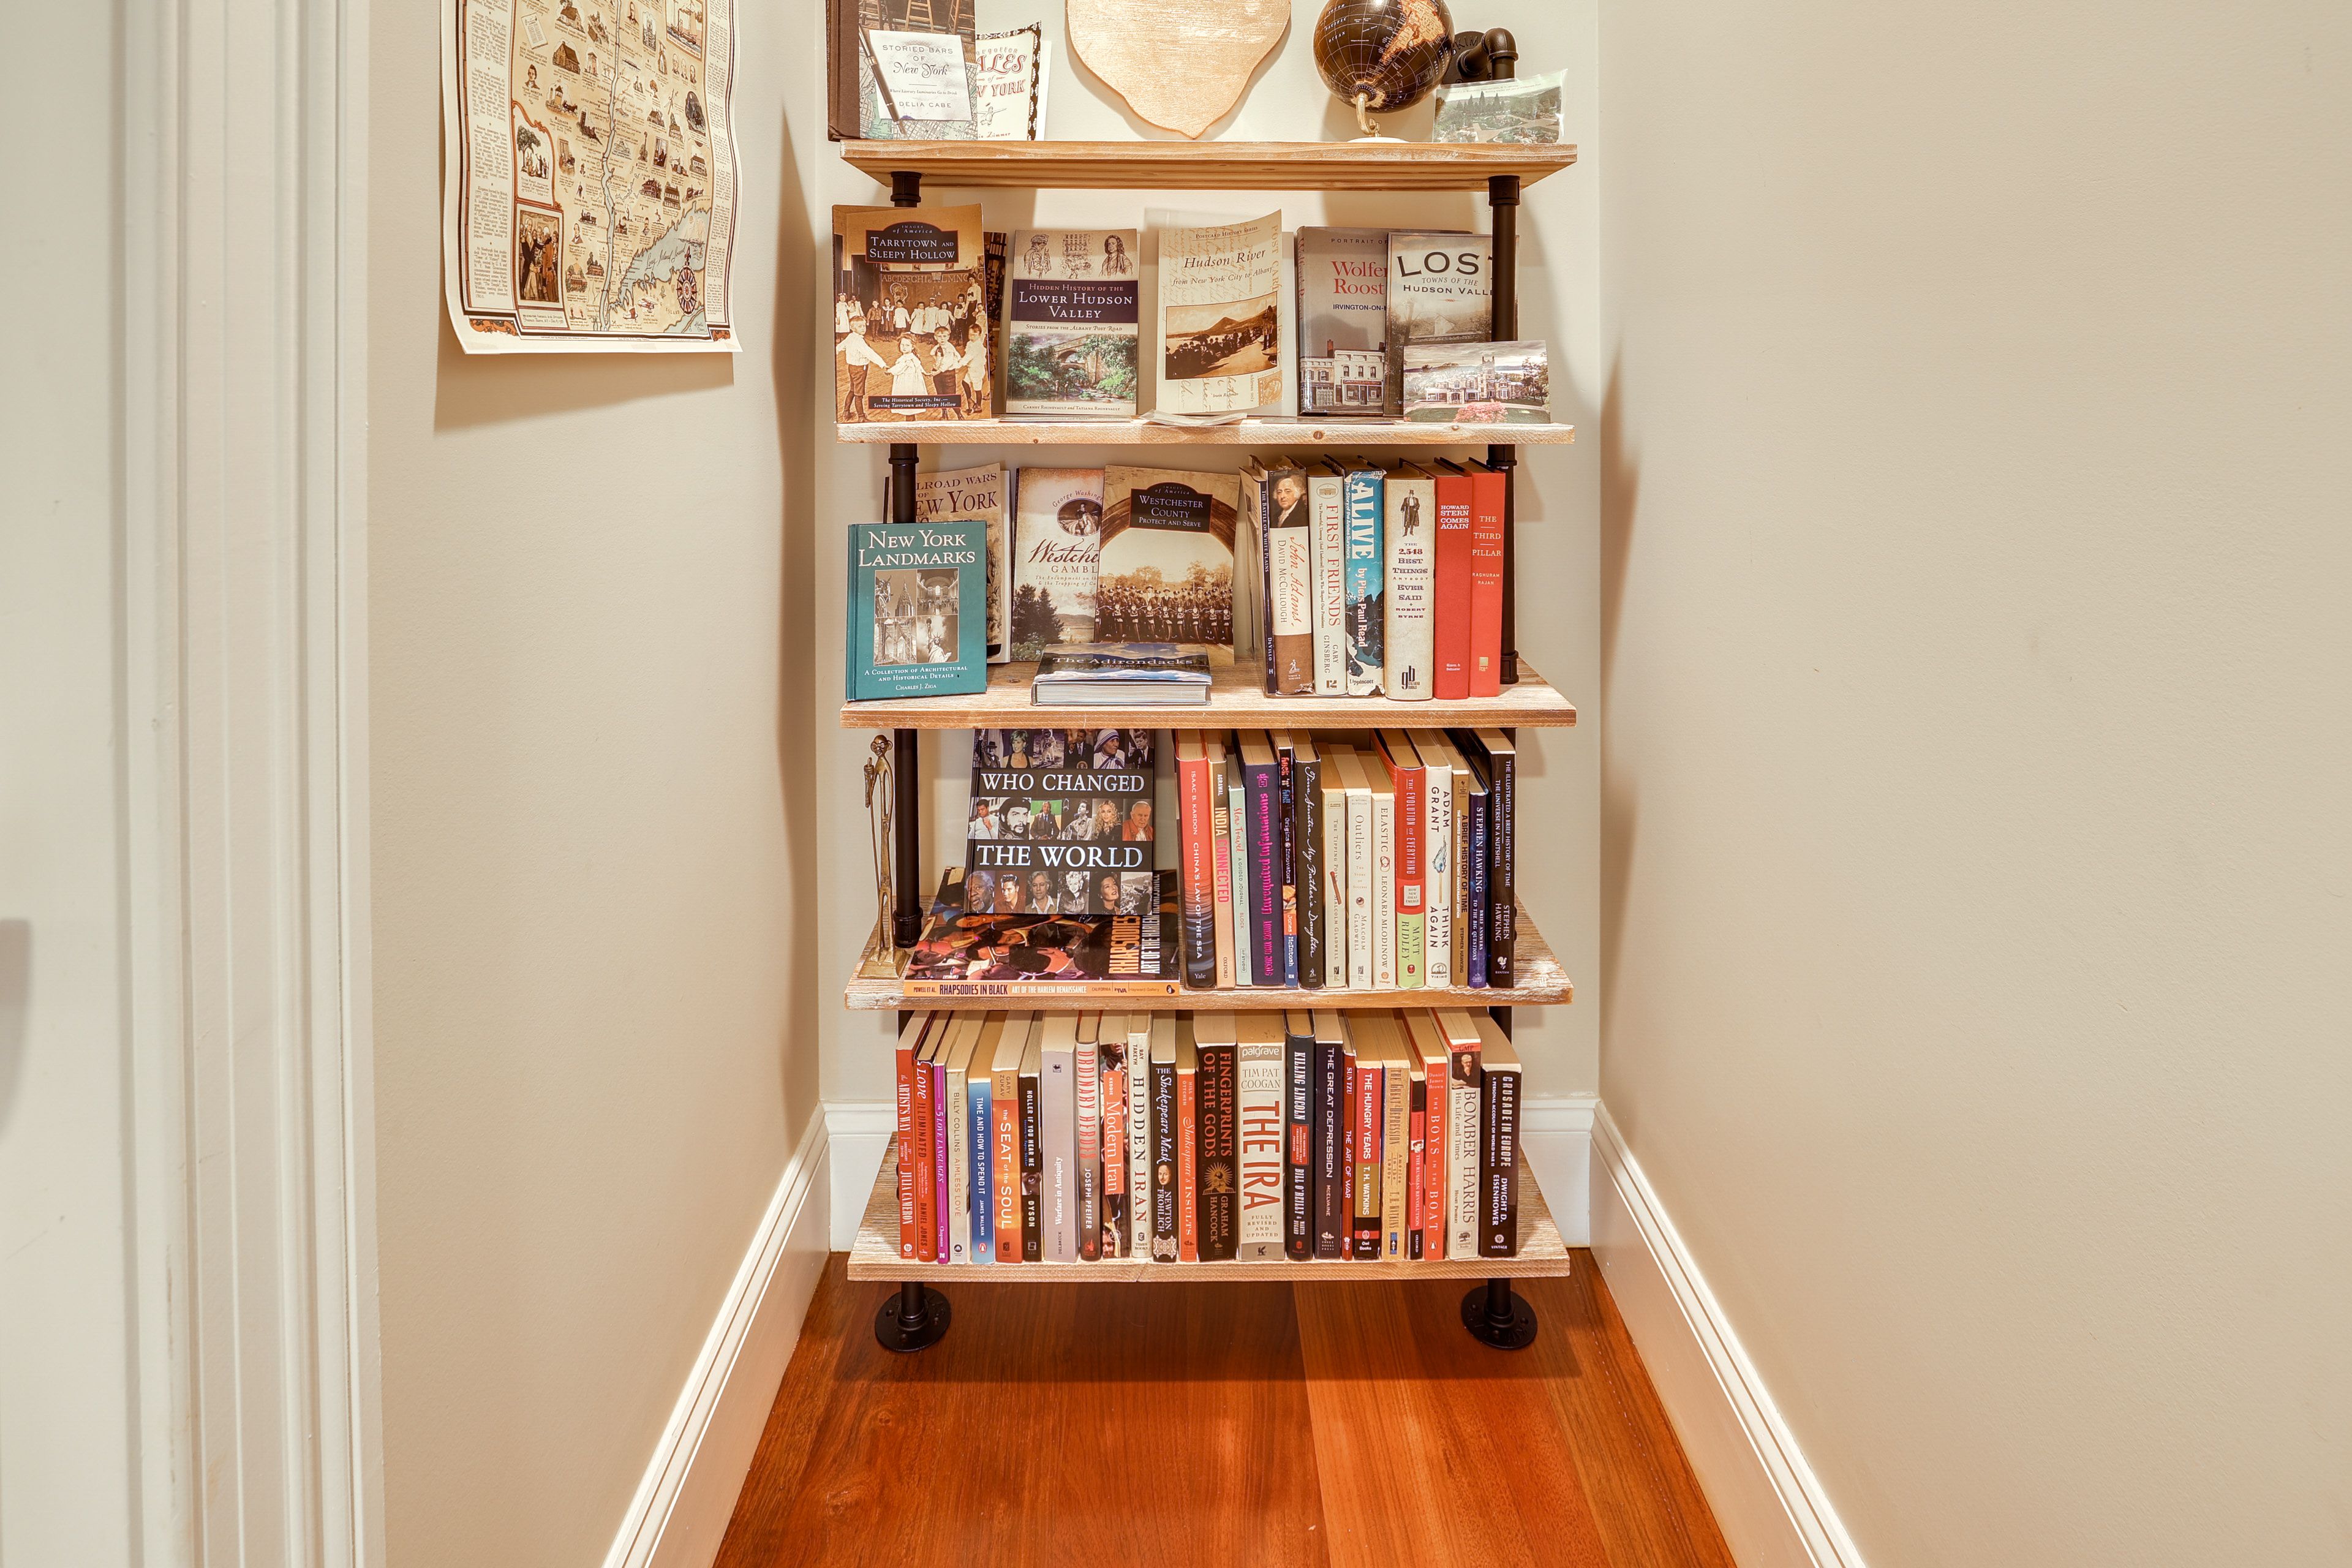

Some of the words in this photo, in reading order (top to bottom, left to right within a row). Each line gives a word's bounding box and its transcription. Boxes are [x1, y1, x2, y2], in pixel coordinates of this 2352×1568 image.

[893, 62, 918, 74] New
[921, 63, 949, 78] York
[991, 80, 1026, 97] YORK
[870, 237, 937, 247] TARRYTOWN
[870, 249, 905, 259] SLEEPY
[911, 250, 955, 259] HOLLOW
[1184, 254, 1230, 268] Hudson
[1237, 249, 1265, 263] River
[1253, 266, 1273, 276] Albany
[1333, 278, 1385, 295] Roost
[1403, 285, 1452, 293] HUDSON
[1019, 292, 1068, 303] LOWER
[1073, 293, 1133, 304] HUDSON
[1049, 306, 1101, 318] VALLEY
[1139, 496, 1203, 508] WESTCHESTER
[1152, 507, 1189, 518] COUNTY
[1327, 505, 1339, 552] FIRST
[1351, 482, 1374, 559] ALIVE
[868, 531, 914, 549] NEW
[918, 529, 967, 547] YORK
[858, 550, 975, 567] LANDMARKS
[1278, 540, 1286, 564] DAVID
[1355, 568, 1368, 579] by
[1327, 559, 1341, 626] FRIENDS
[1357, 580, 1367, 601] Piers
[1357, 603, 1367, 625] Paul
[1358, 625, 1368, 647] Read
[982, 774, 1034, 790] WHO
[1042, 775, 1144, 791] CHANGED
[1355, 815, 1364, 860] Outliers
[977, 845, 1031, 866] THE
[1038, 846, 1142, 867] WORLD
[1216, 839, 1229, 903] CONNECTED
[1195, 906, 1201, 918] OF
[940, 985, 978, 995] RHAPSODIES
[980, 985, 987, 995] IN
[989, 985, 1008, 995] BLACK
[1242, 1047, 1280, 1058] palgrave
[1242, 1079, 1280, 1089] COOGAN
[1220, 1052, 1232, 1156] FINGERPRINTS
[1133, 1076, 1145, 1161] HIDDEN
[1242, 1101, 1280, 1155] THE
[1464, 1090, 1477, 1159] BOMBER
[1106, 1101, 1121, 1160] Modern
[1430, 1115, 1441, 1155] BOYS
[1001, 1123, 1011, 1163] SEAT
[900, 1171, 912, 1191] JULIA
[1107, 1163, 1121, 1192] Iran
[1243, 1163, 1281, 1211] IRA
[1134, 1171, 1147, 1223] IRAN
[1463, 1166, 1475, 1224] HARRIS
[901, 1194, 913, 1225] CAMERON
[1001, 1186, 1012, 1229] SOUL
[1429, 1191, 1439, 1231] BOAT
